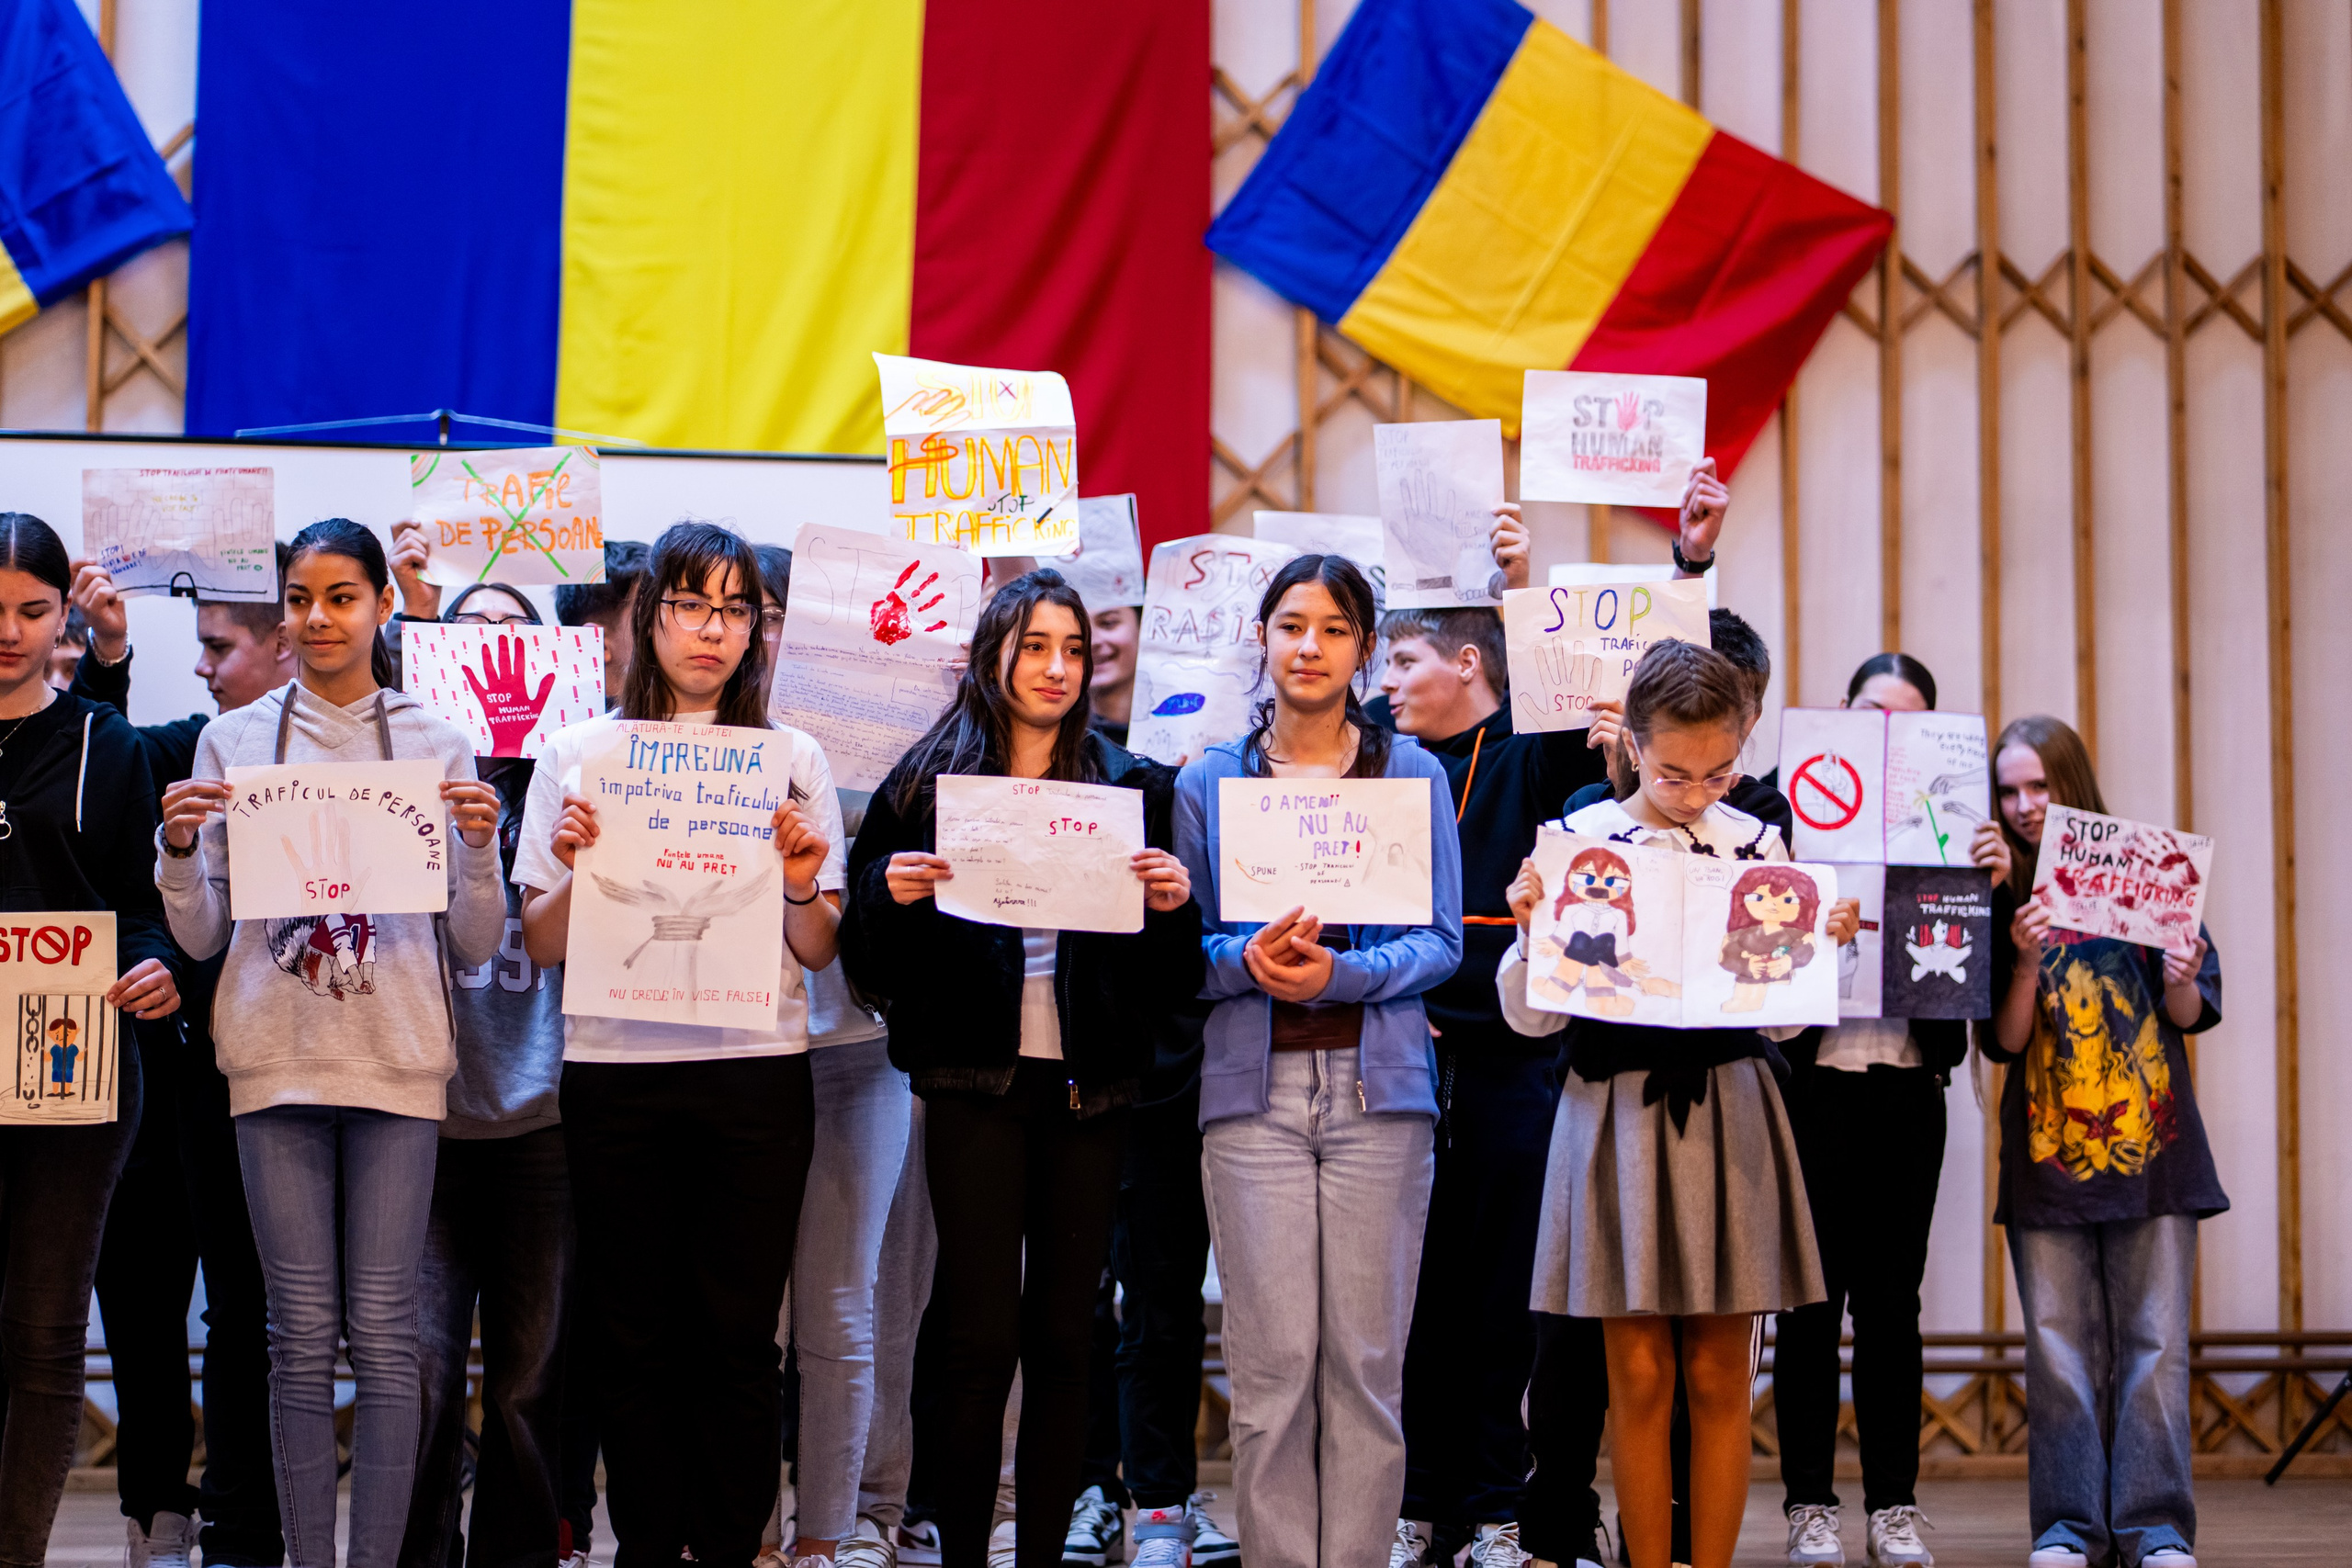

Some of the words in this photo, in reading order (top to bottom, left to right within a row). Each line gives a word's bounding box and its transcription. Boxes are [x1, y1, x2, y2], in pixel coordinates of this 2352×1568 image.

[1573, 391, 1665, 431] STP
[1571, 432, 1663, 457] HUMAN
[891, 434, 1073, 503] HUMAN
[1573, 454, 1661, 473] TRAFFICKING
[435, 518, 473, 547] DE
[480, 516, 605, 554] PERSOANE
[1183, 549, 1294, 593] STO
[1544, 586, 1652, 637] STOP
[486, 693, 512, 704] STOP
[498, 705, 530, 715] HUMAN
[616, 721, 684, 734] ALĂTURĂ-TE
[693, 726, 732, 738] LUPTEI
[626, 734, 764, 774] ÎMPREUNĂ
[599, 777, 683, 805] împotriva
[696, 782, 779, 812] traficului
[1012, 784, 1040, 795] STOP
[349, 788, 371, 800] DE
[378, 791, 441, 871] PERSOANE
[649, 809, 670, 829] de
[689, 818, 773, 840] persoane
[1049, 818, 1098, 835] STOP
[1299, 814, 1328, 838] NU
[1343, 811, 1368, 833] AU
[2067, 817, 2119, 844] STOP
[657, 858, 673, 868] NU
[680, 860, 695, 871] AU
[697, 852, 724, 860] umane
[2061, 844, 2133, 868] HUMAN
[1251, 866, 1277, 876] SPUNE
[306, 878, 351, 899] STOP
[1942, 893, 1979, 903] HUMAN
[609, 988, 627, 999] NU
[632, 989, 669, 1001] CREDE
[673, 988, 685, 1001] ÎN
[693, 989, 720, 1001] VISE
